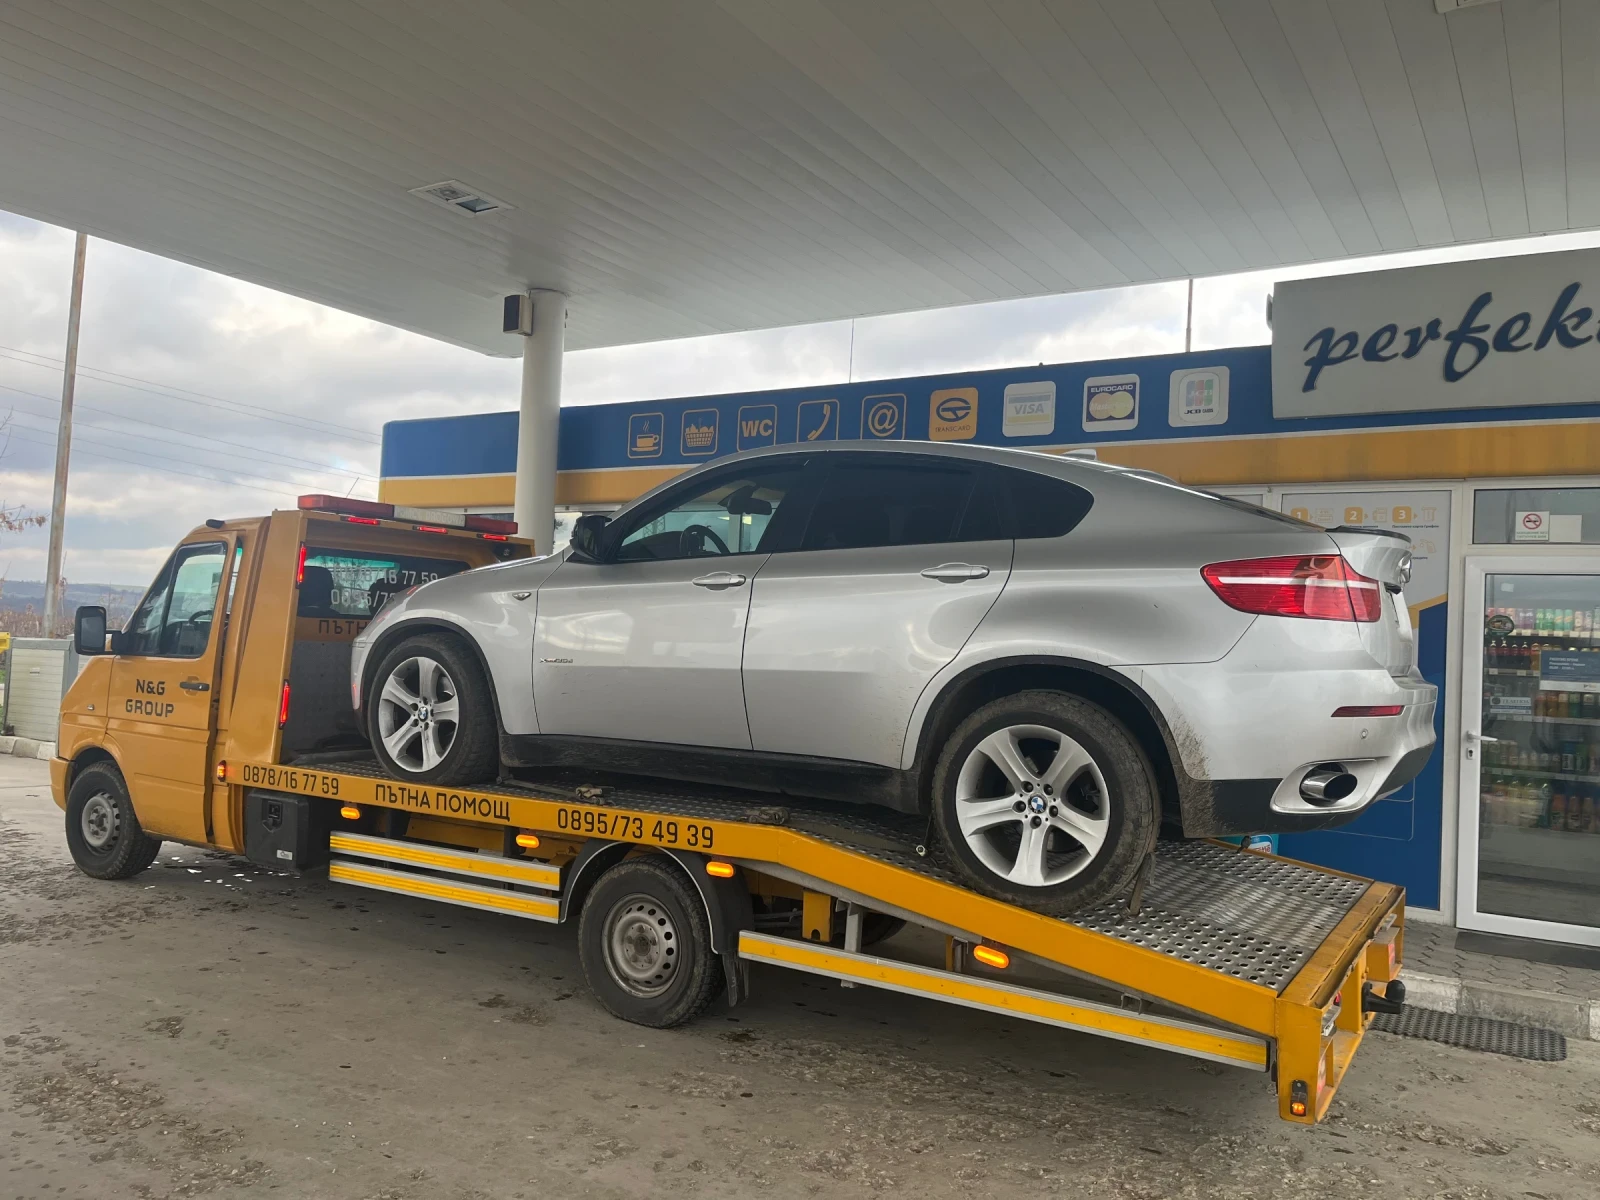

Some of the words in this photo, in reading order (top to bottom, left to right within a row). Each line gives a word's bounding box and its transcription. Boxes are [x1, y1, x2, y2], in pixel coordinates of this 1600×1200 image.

[1302, 281, 1600, 393] perfek
[1091, 384, 1133, 393] EUROCARD
[1013, 402, 1044, 415] VISA
[741, 419, 773, 438] WC
[935, 425, 971, 433] TRANSCARD
[1349, 510, 1358, 521] 2
[1398, 509, 1407, 520] 3
[402, 570, 417, 585] 77
[330, 589, 396, 608] 0895/7
[319, 619, 368, 635] ПЪТН
[136, 679, 166, 696] N&G
[125, 698, 174, 718] GROUP
[243, 764, 298, 789] 0878/16
[302, 773, 317, 792] 77
[321, 776, 339, 796] 59
[375, 783, 431, 809] ПЪТНА
[436, 792, 511, 822] ПОМОЩ
[557, 808, 643, 839] 0895/73
[652, 820, 679, 844] 49
[687, 824, 714, 849] 39
